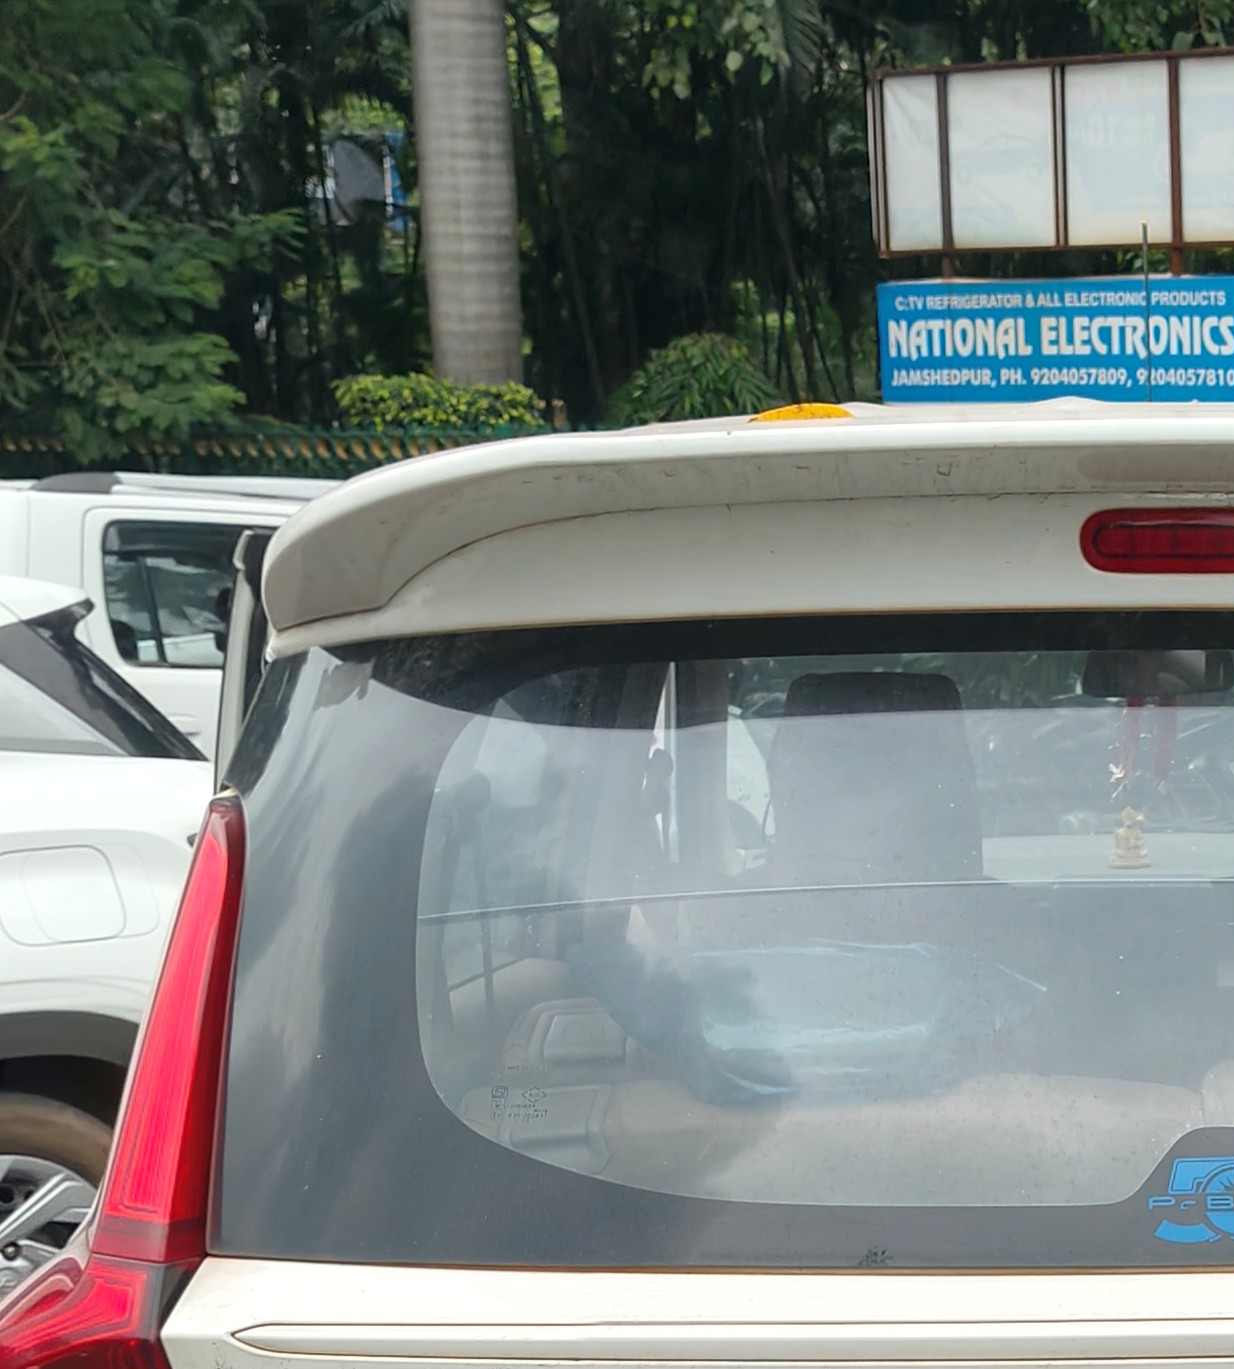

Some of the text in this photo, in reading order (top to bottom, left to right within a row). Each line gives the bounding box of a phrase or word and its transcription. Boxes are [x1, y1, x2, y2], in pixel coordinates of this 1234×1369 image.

[926, 293, 1023, 310] REFRIGERATOR
[1026, 293, 1034, 308] &
[1037, 291, 1062, 307] ALL
[1064, 290, 1147, 307] ELECTRONIC
[1151, 290, 1226, 306] PRODUCTS
[887, 316, 1033, 361] NATIONAL
[891, 367, 998, 388] JAMSHEDPUR,
[1001, 368, 1028, 386] PH.
[1031, 367, 1132, 388] 9204057809,
